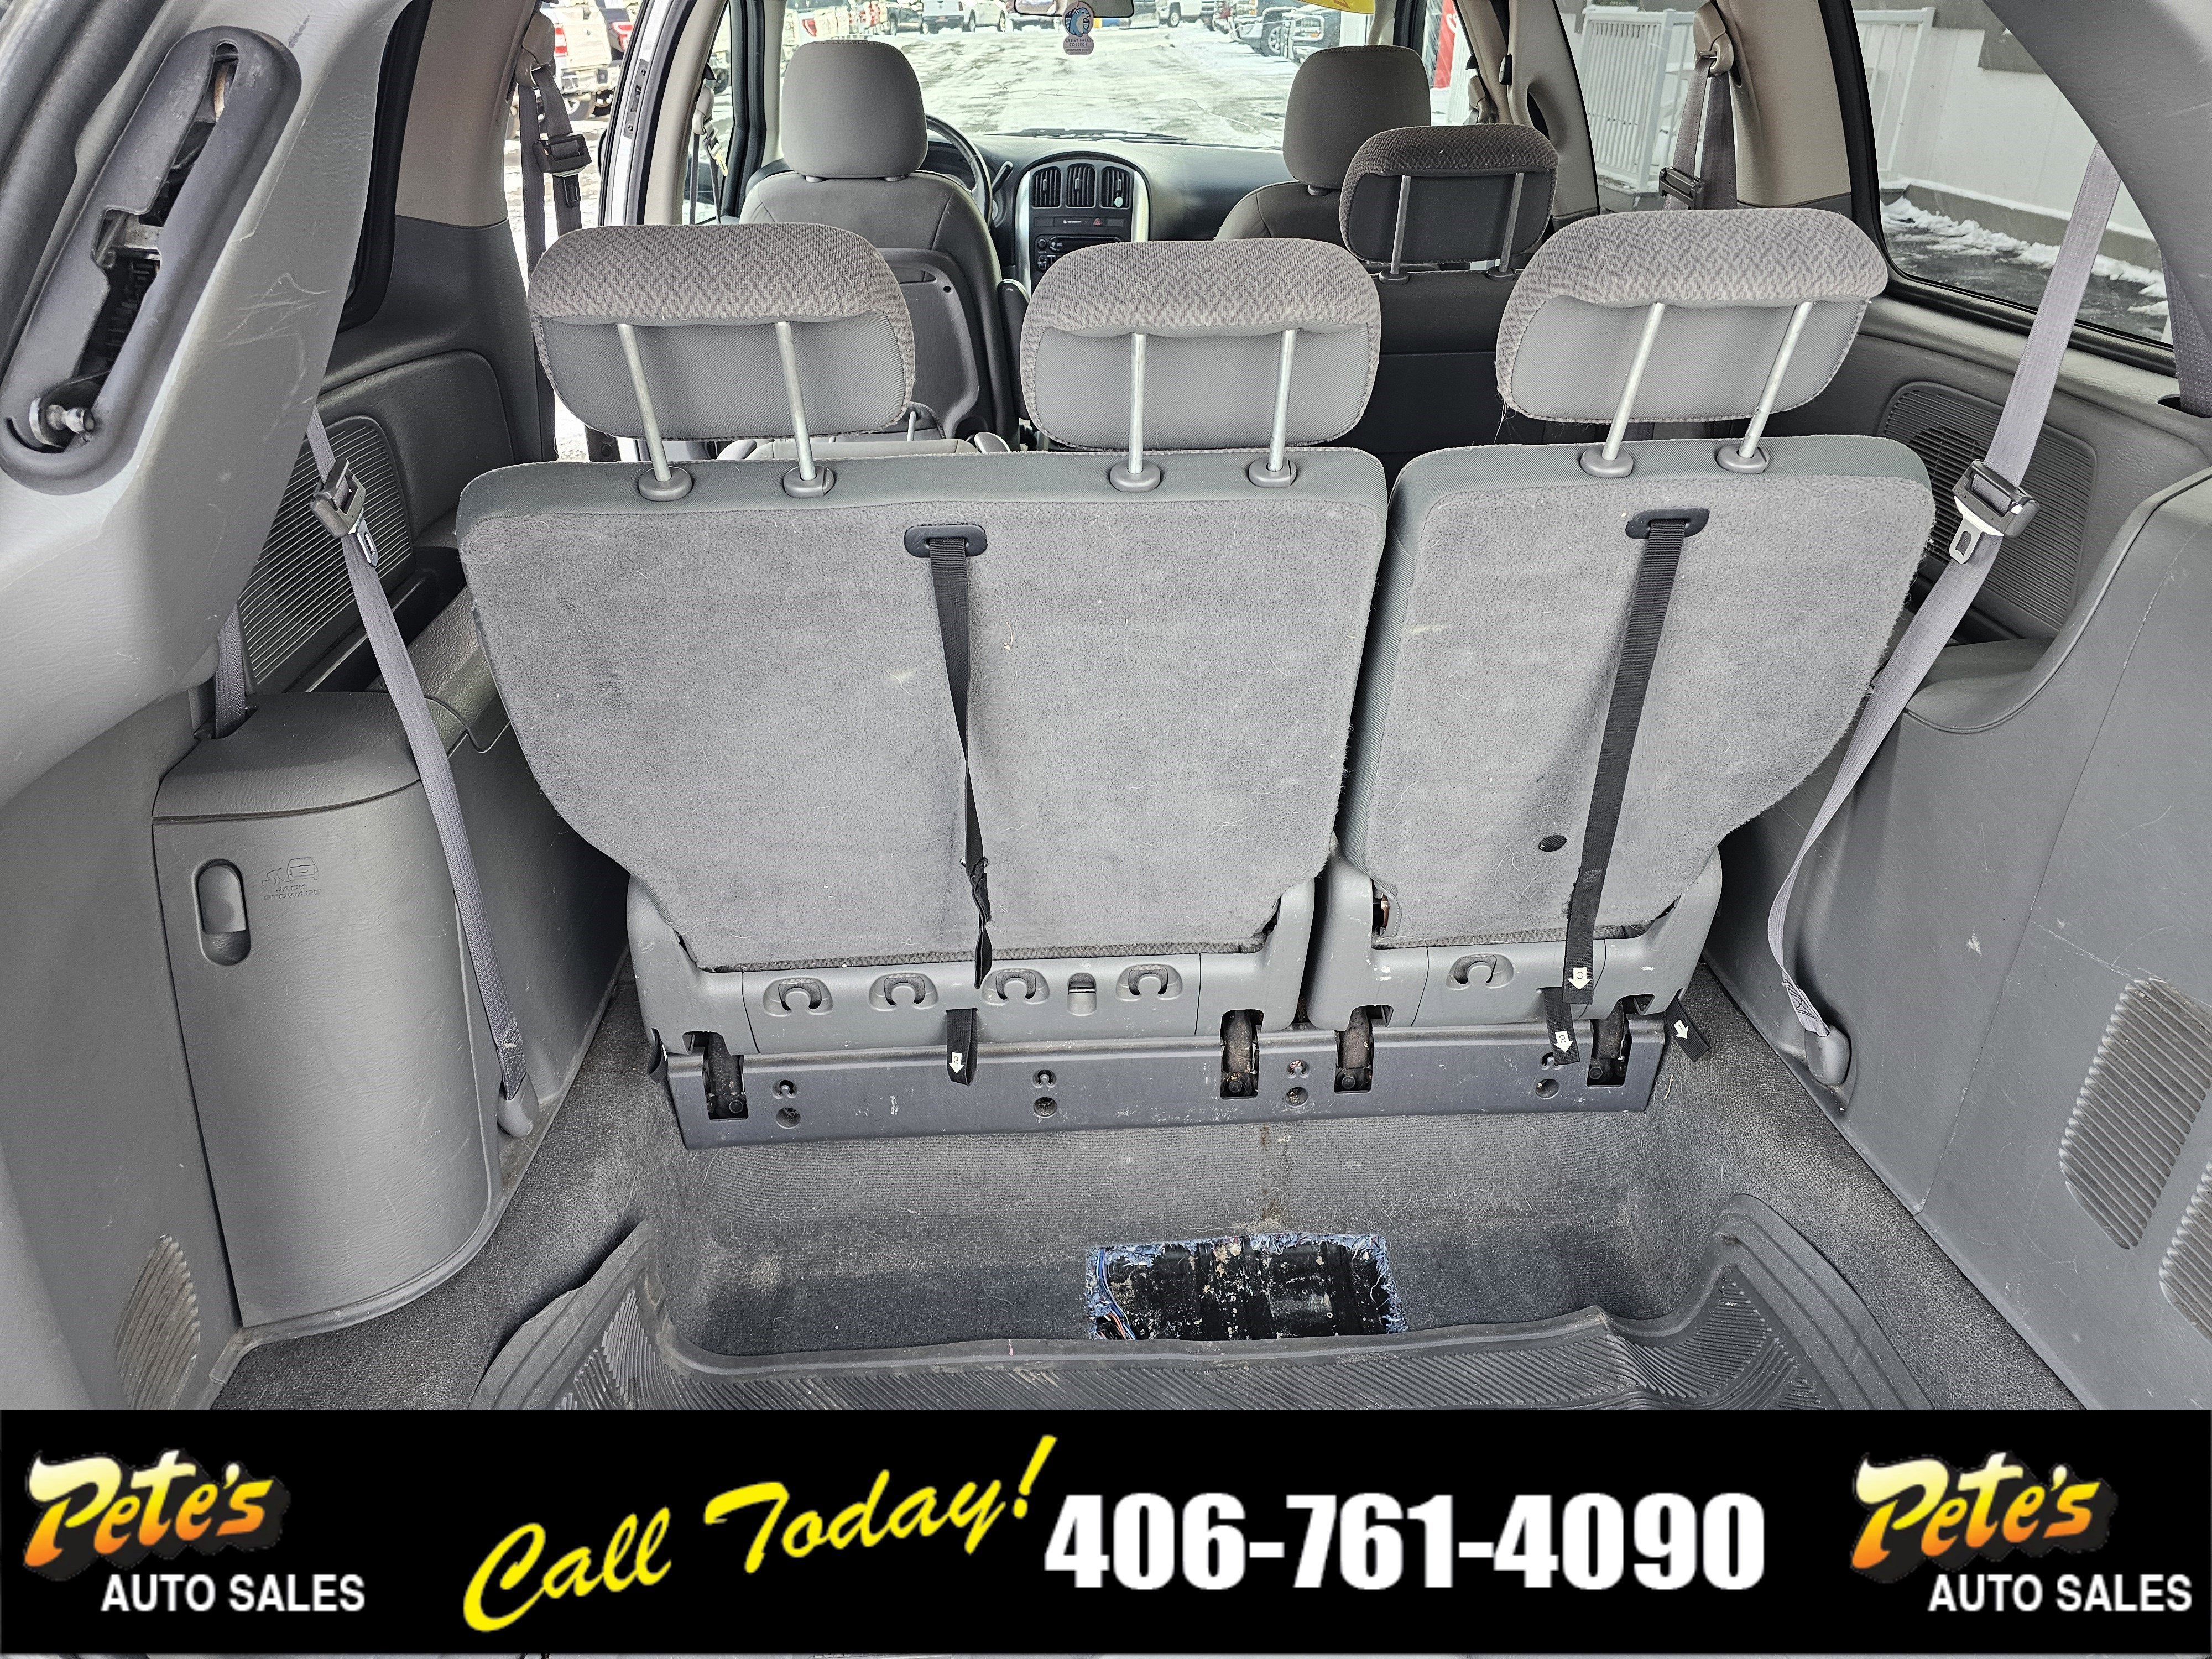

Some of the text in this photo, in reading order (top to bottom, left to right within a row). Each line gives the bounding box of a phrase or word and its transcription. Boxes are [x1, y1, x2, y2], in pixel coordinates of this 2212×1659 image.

[275, 884, 307, 893] JACK
[264, 889, 321, 901] STOWAGE
[953, 1056, 959, 1065] 2
